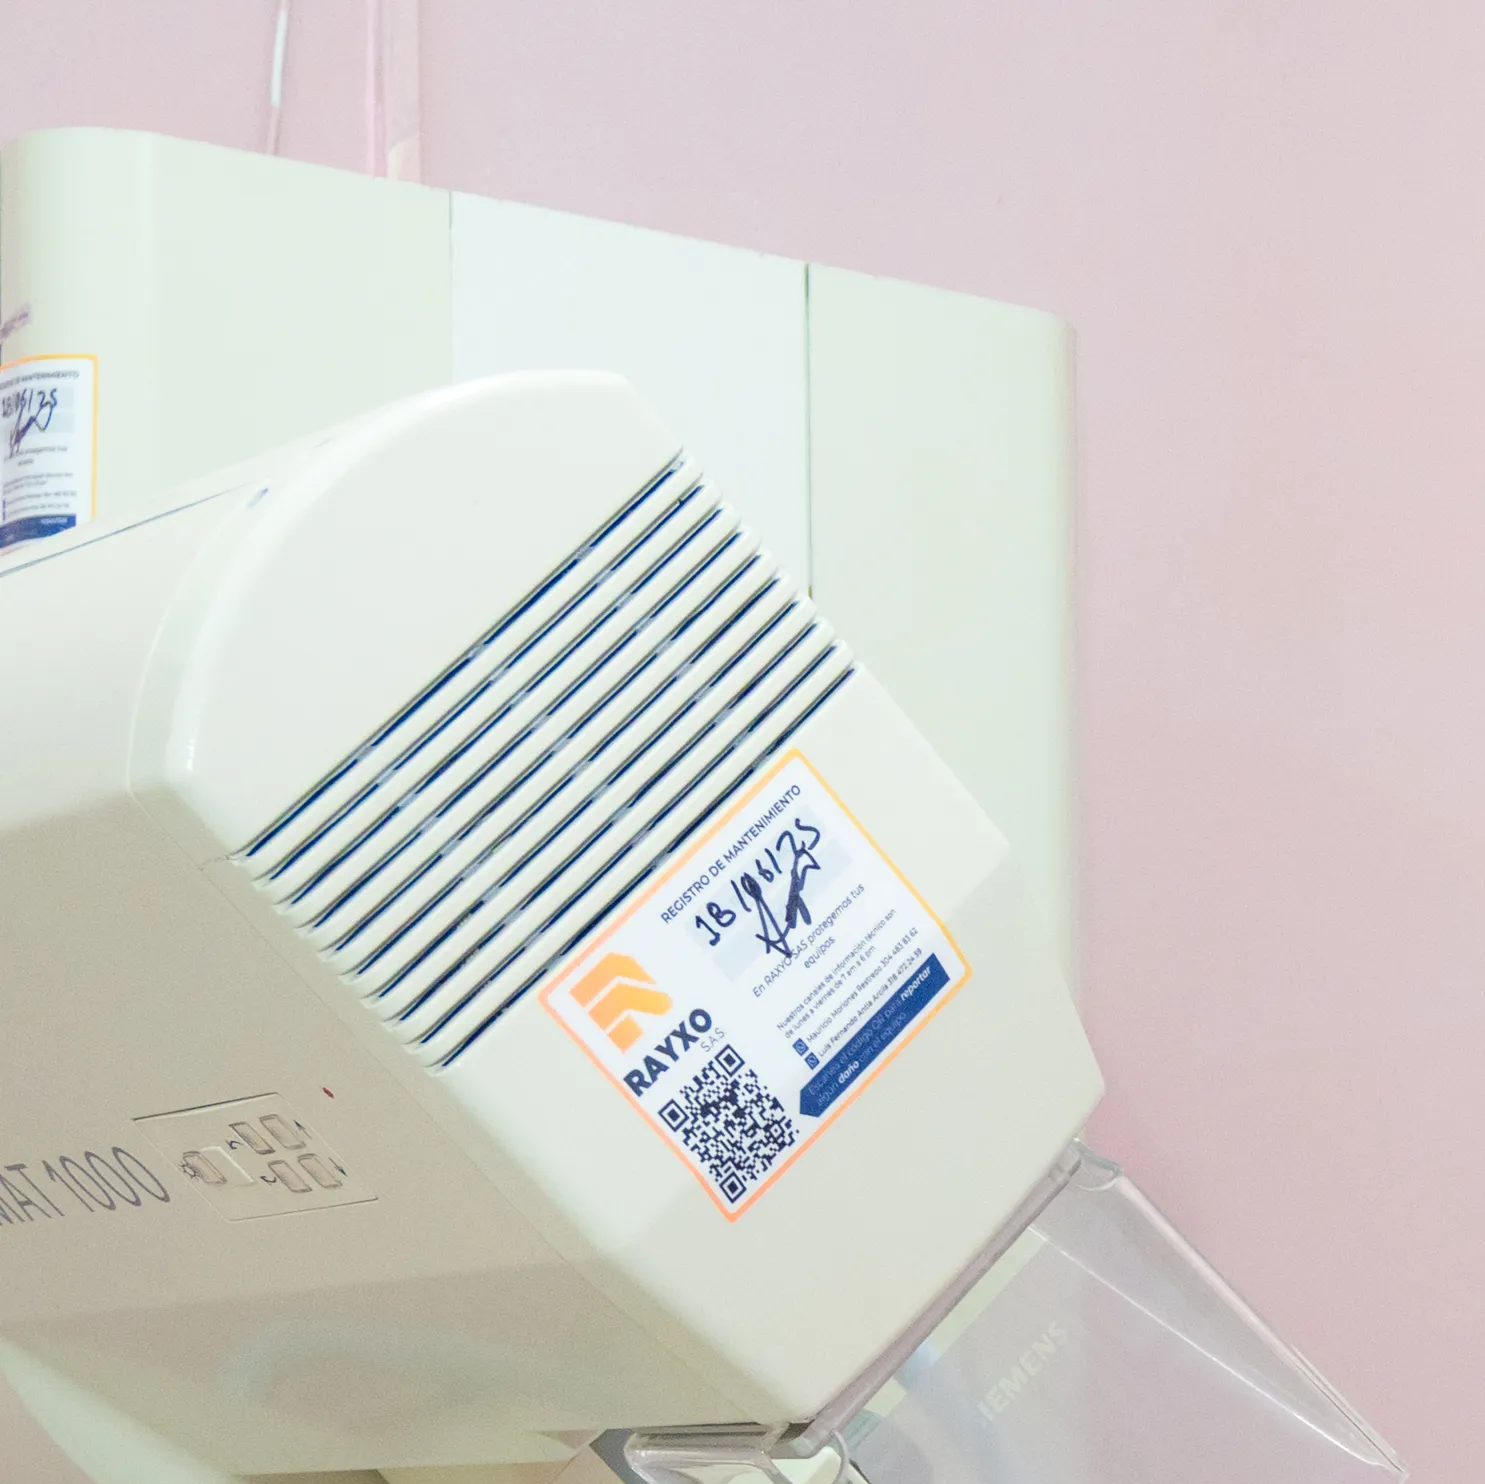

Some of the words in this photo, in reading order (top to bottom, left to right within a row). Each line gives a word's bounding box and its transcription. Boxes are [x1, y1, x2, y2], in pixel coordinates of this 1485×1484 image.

[660, 872, 711, 924] REGISTRO
[707, 859, 726, 877] DE
[722, 783, 802, 863] MANTENIMIENTO
[751, 982, 766, 997] En
[789, 939, 809, 959] SAS
[804, 895, 854, 945] protegemos
[849, 882, 865, 899] tus
[776, 1002, 805, 1031] Nuestros
[801, 981, 826, 1005] canales
[791, 1012, 810, 1030] lunes
[812, 987, 835, 1009] viernes
[805, 1015, 833, 1043] Mauricio
[855, 964, 883, 992] Restrepo
[897, 965, 935, 1002] reportar
[622, 1003, 716, 1098] RAYXO
[816, 1042, 831, 1057] Luis
[828, 1014, 859, 1044] Fernando
[835, 1058, 861, 1084] daño
[42, 1147, 171, 1212] 1000
